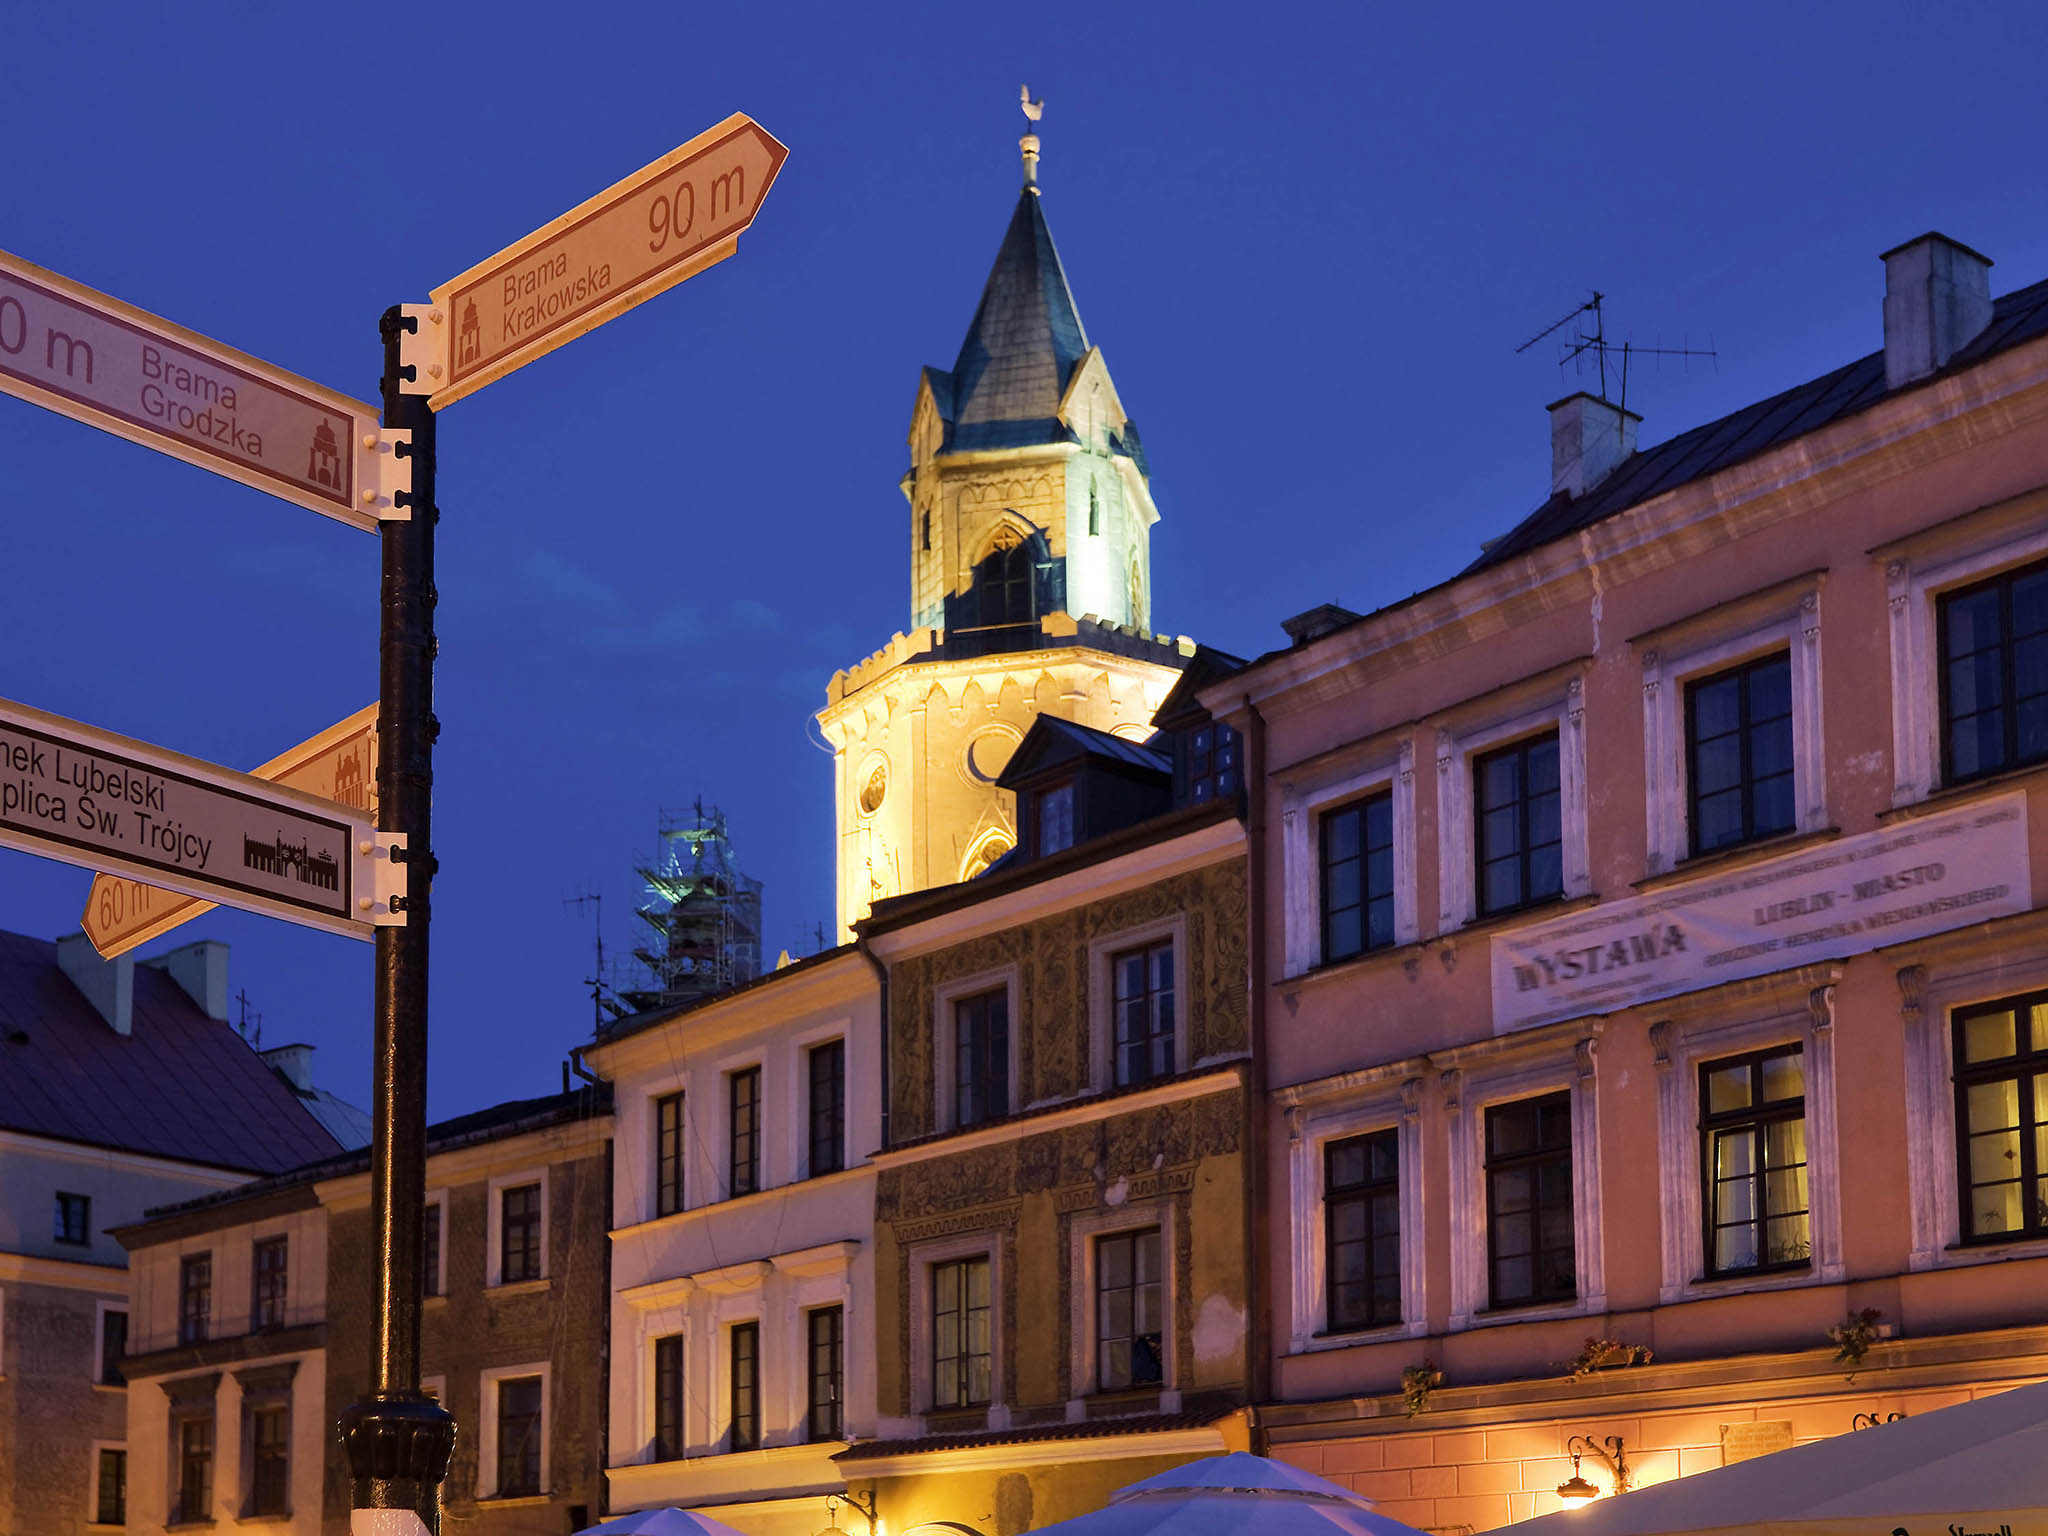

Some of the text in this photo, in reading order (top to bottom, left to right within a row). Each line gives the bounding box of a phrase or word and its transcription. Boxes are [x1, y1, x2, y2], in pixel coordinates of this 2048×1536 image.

[649, 165, 745, 253] 90 m
[502, 264, 611, 342] Krakowska
[503, 252, 568, 307] Brama
[47, 328, 94, 385] m
[142, 343, 237, 411] Brama
[141, 384, 263, 458] Grodzka
[55, 749, 165, 812] Lubelski
[77, 789, 124, 839] Św.
[134, 810, 212, 869] Trójcy
[100, 880, 124, 931] 60
[1512, 924, 1687, 992] WYSTAWA
